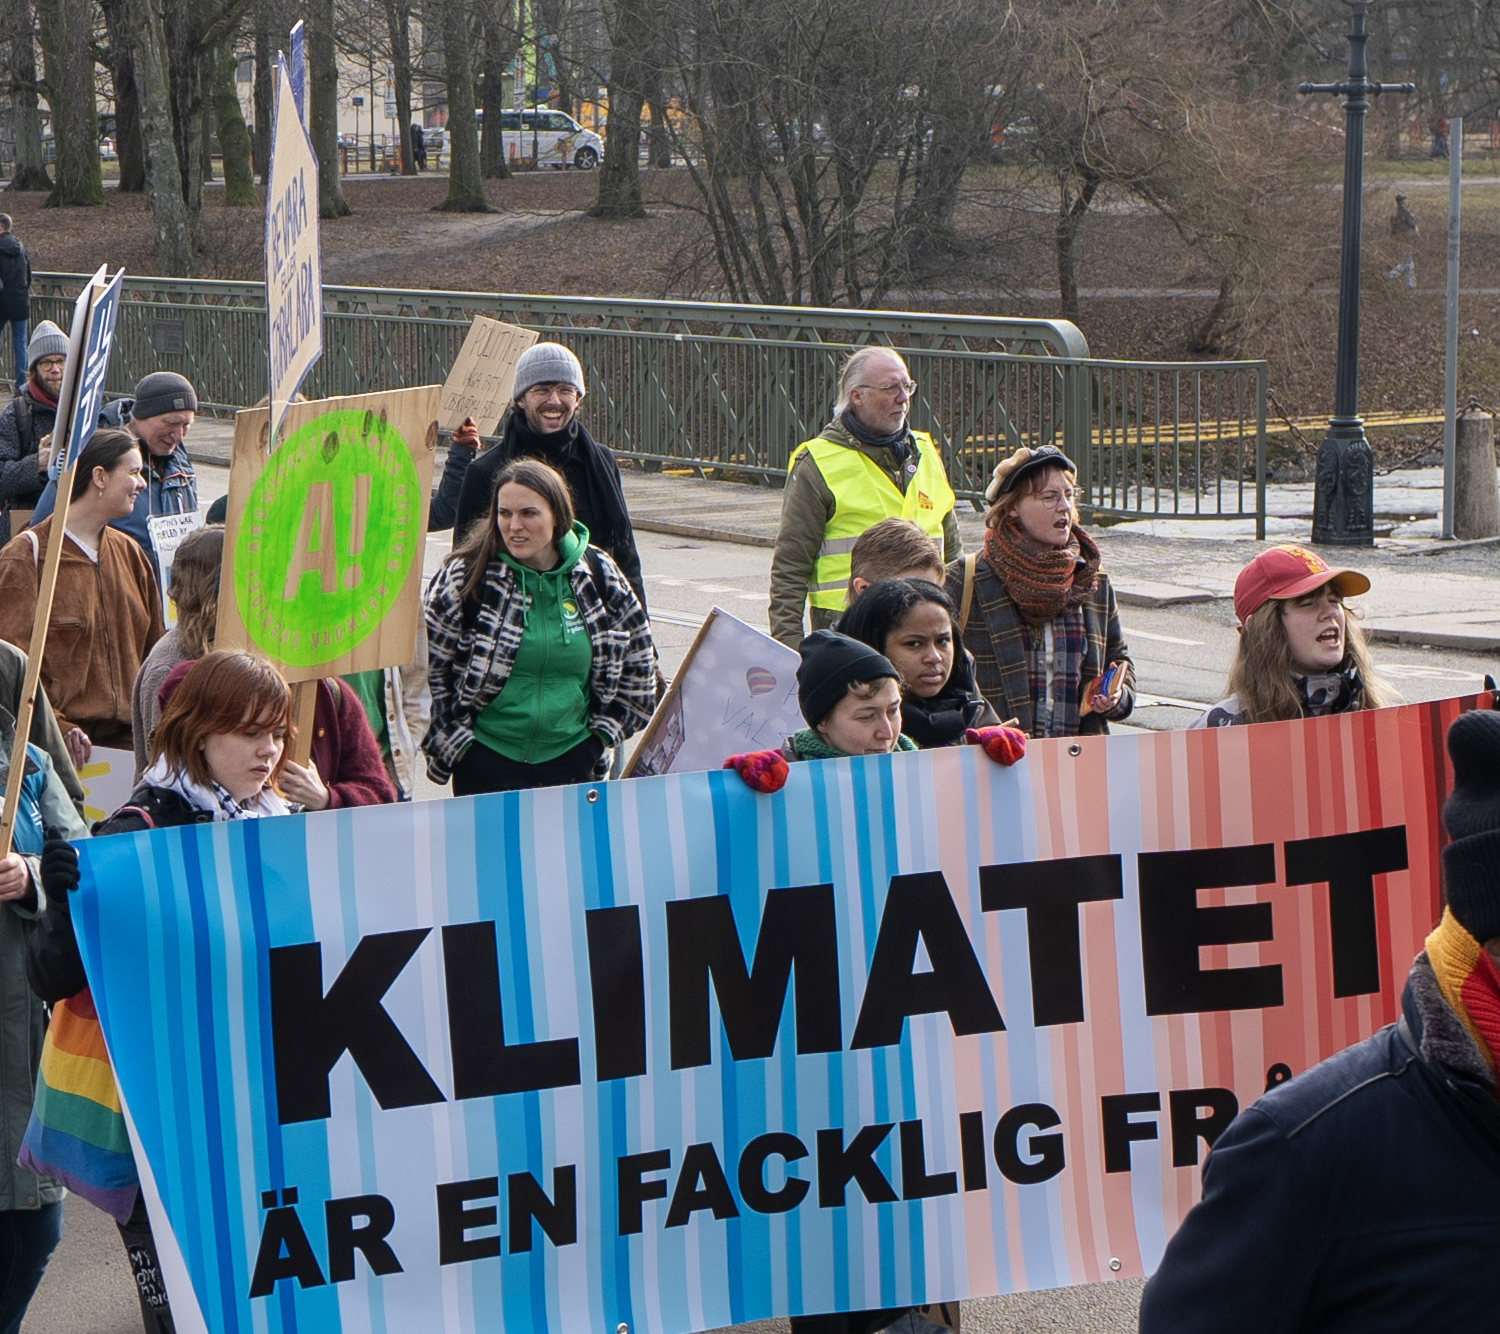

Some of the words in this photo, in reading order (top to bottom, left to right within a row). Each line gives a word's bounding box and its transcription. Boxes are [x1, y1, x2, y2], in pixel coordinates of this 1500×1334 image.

[281, 473, 373, 602] A!
[269, 825, 1409, 1124] KLIMATET
[249, 1186, 404, 1299] ÄR
[438, 1164, 578, 1267] EN
[618, 1102, 1067, 1236] FACKLIG
[1101, 1063, 1292, 1174] FR
